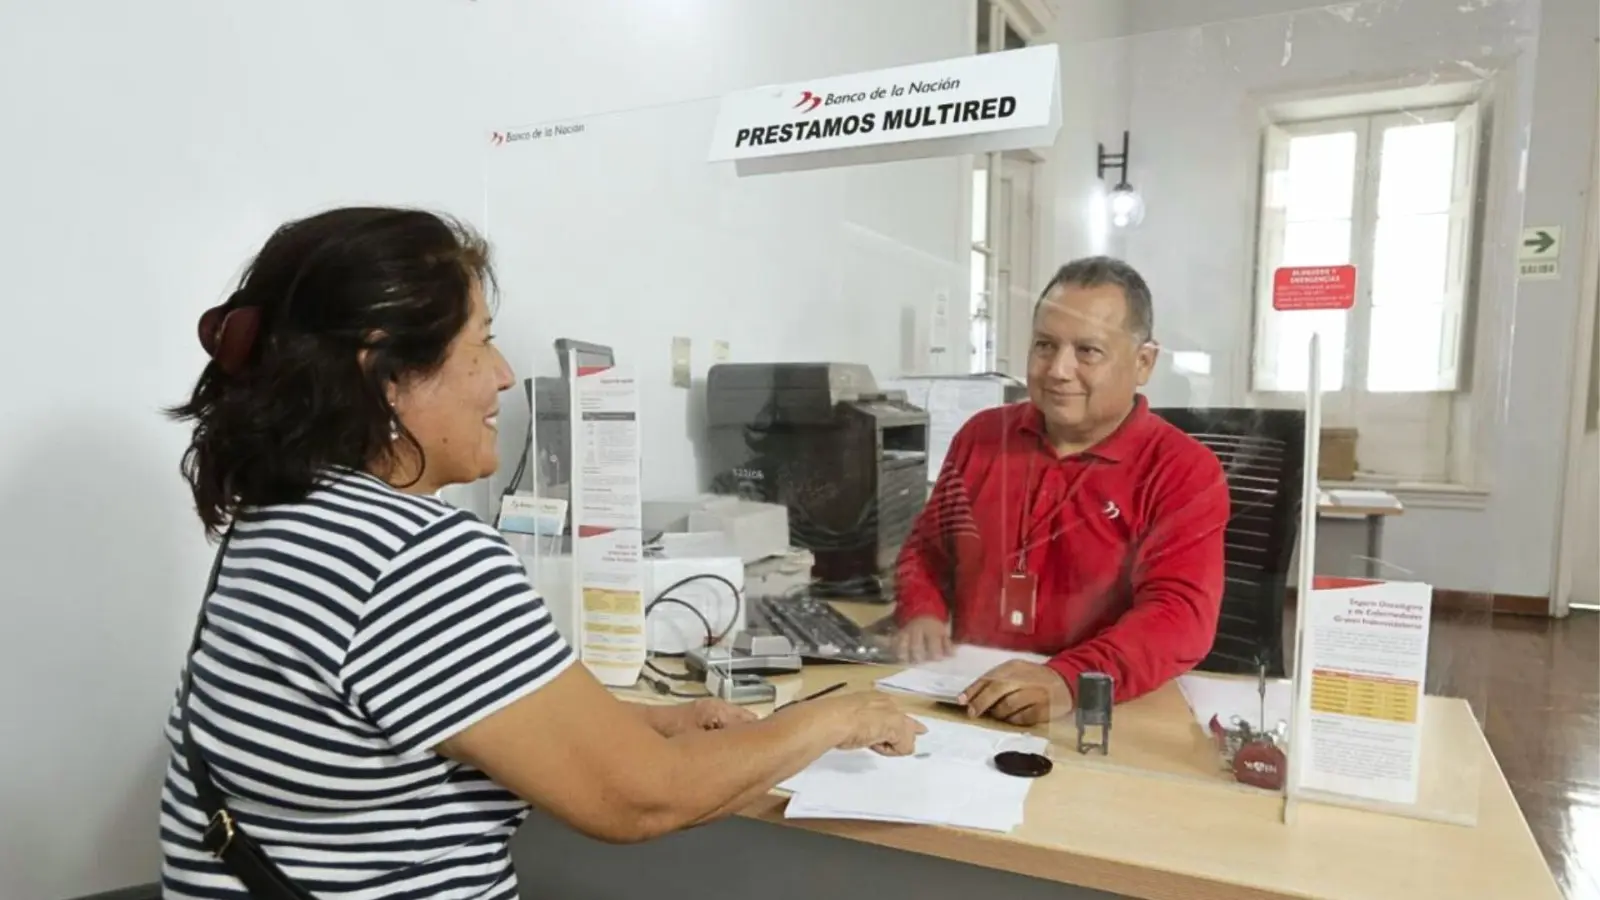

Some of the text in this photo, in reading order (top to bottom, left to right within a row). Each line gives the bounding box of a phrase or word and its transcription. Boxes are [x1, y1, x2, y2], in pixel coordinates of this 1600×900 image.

[824, 77, 961, 106] Banco de la Nación
[506, 131, 531, 143] Banco
[532, 127, 542, 140] de
[544, 126, 553, 137] la
[735, 96, 1017, 148] PRESTAMOS MULTIRED
